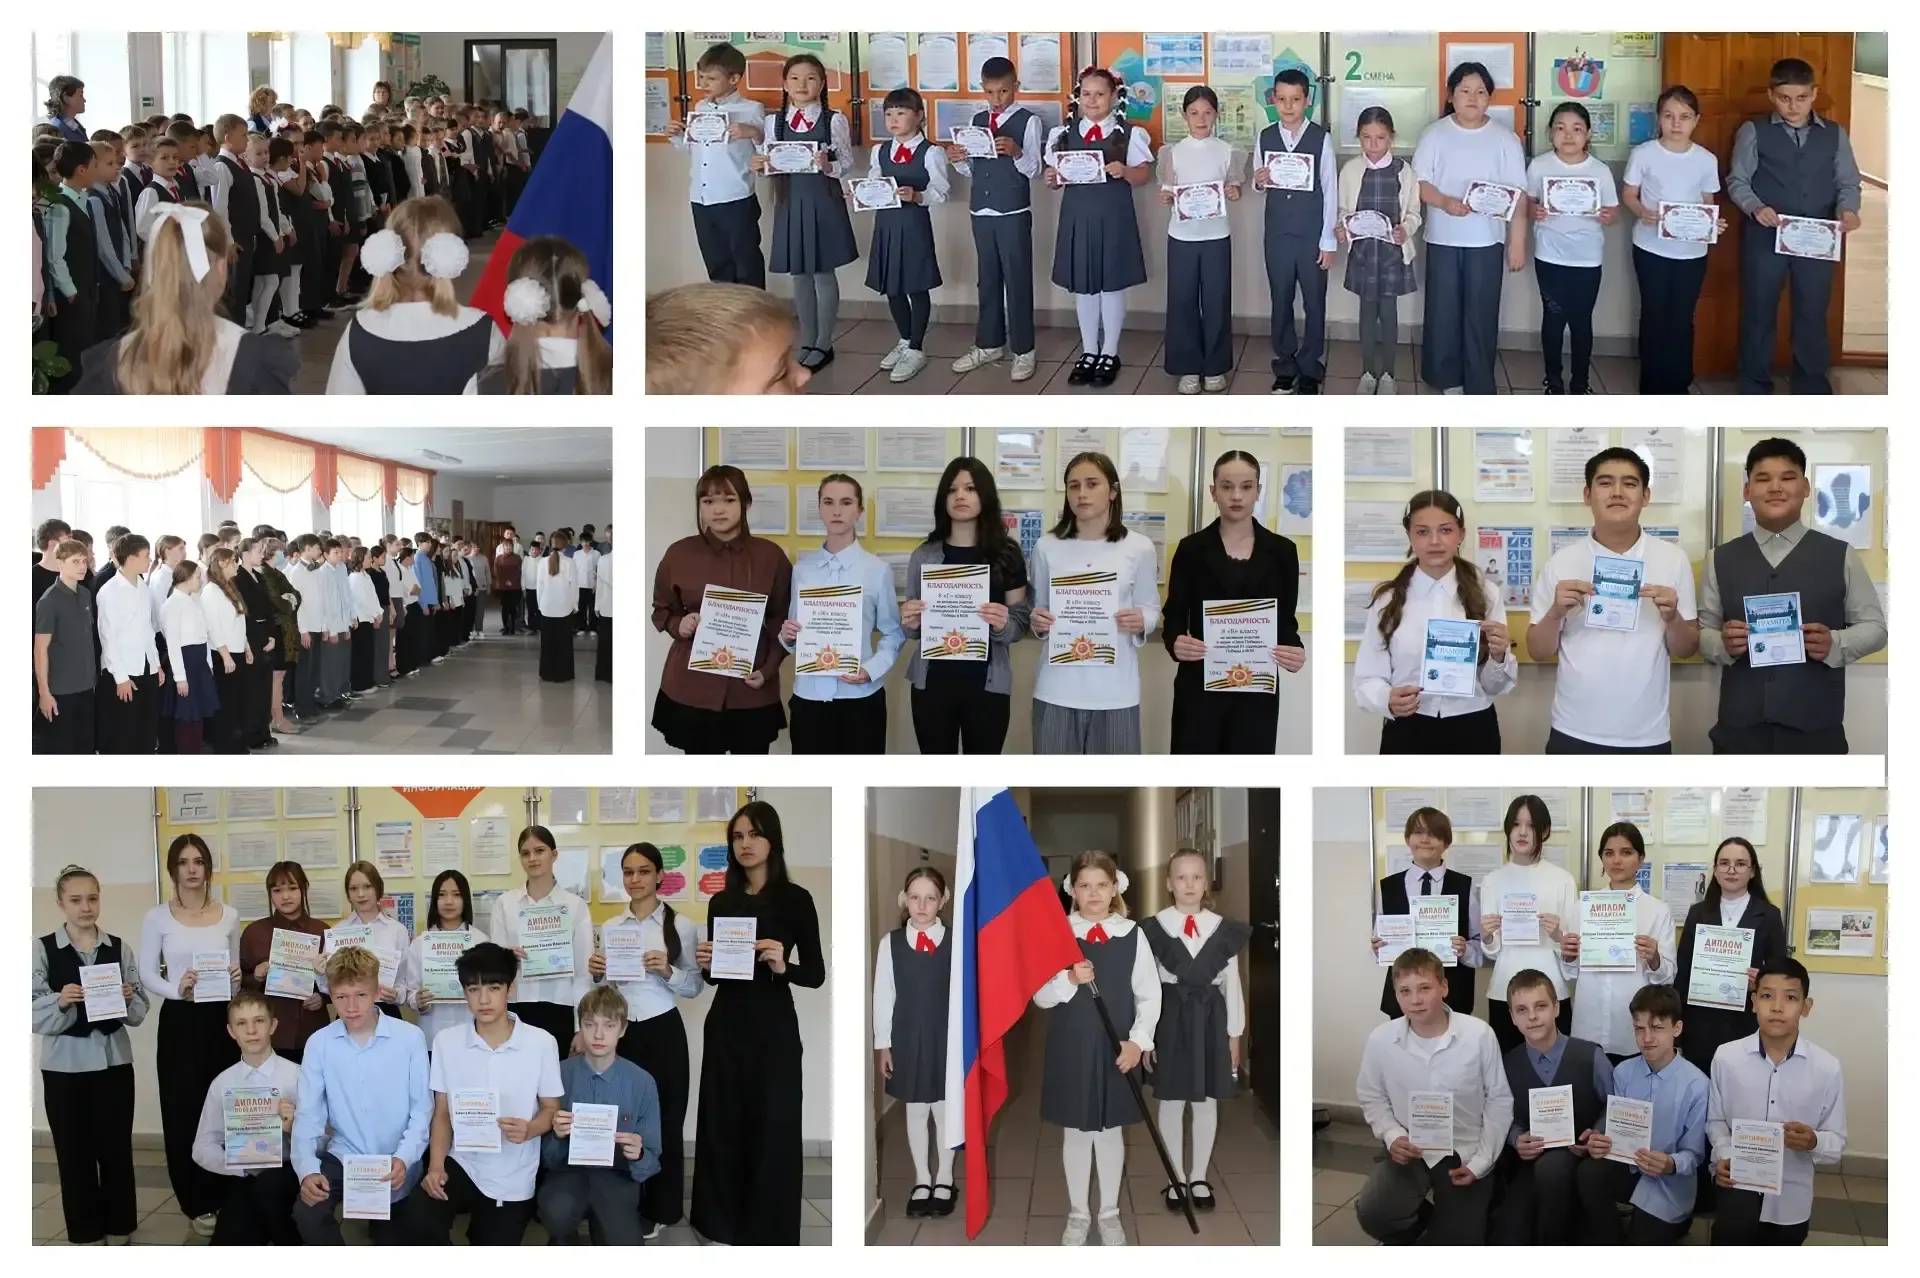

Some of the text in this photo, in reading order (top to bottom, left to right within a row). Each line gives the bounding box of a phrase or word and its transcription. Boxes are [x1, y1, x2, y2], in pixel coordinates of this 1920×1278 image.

[1345, 51, 1395, 80] 2 СМЕНА
[1601, 583, 1633, 593] ГРАМОТА
[708, 601, 759, 615] БЛАГОДАРНОСТЬ
[1758, 618, 1791, 626] ГРАМОТА
[1436, 647, 1469, 655] ГРАМОТА
[1590, 904, 1626, 912] ДИПЛОМ
[527, 916, 561, 926] ДИПЛОМ
[280, 940, 311, 951] ДИПЛОМ
[335, 936, 366, 946] ДИПЛОМ
[1704, 938, 1742, 950] ДИПЛОМ
[1704, 947, 1742, 955] ПОБЕДИТЕЛЯ
[234, 1098, 271, 1107] ДИПЛОМ
